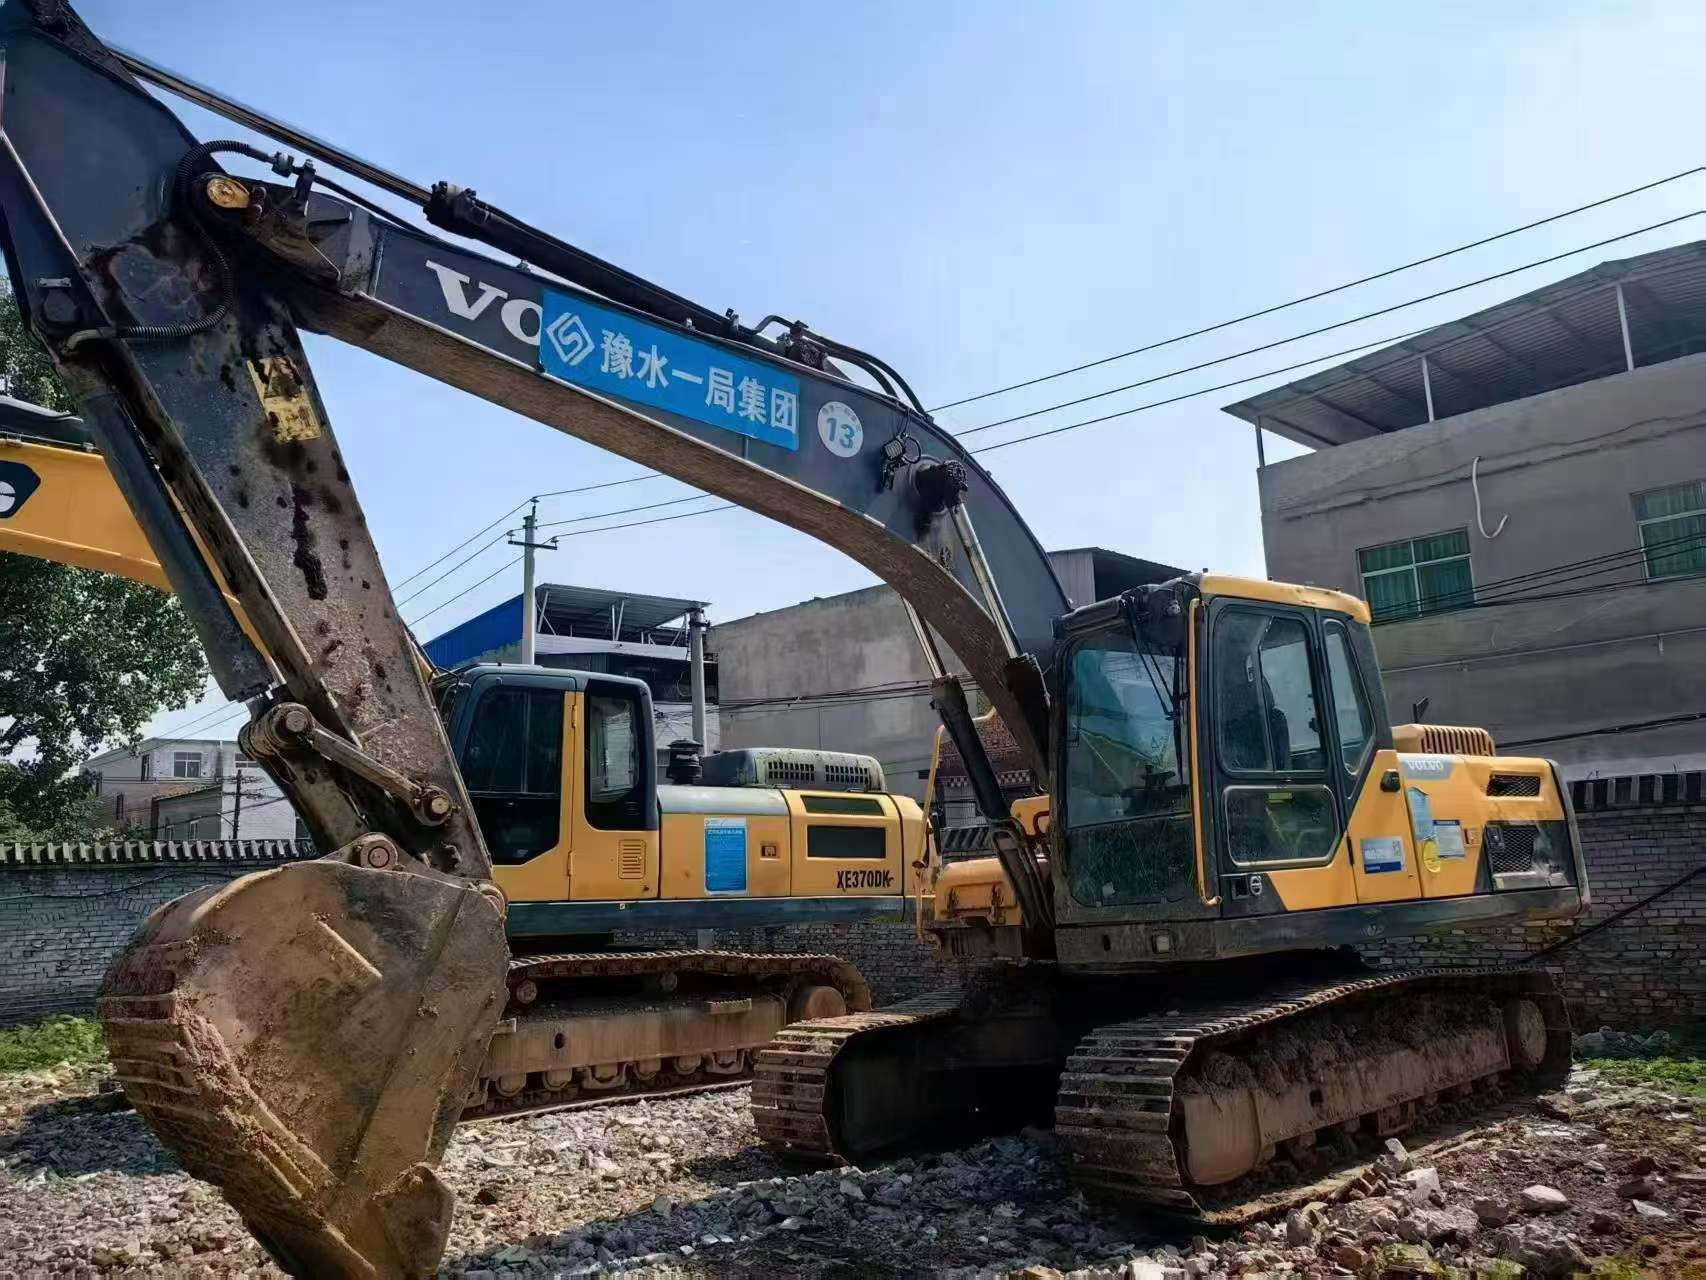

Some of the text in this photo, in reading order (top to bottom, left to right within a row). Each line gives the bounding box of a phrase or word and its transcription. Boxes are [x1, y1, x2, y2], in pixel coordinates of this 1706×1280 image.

[600, 328, 798, 434] 豫水一局集团
[826, 417, 855, 449] 13
[836, 869, 893, 889] XE370DK
